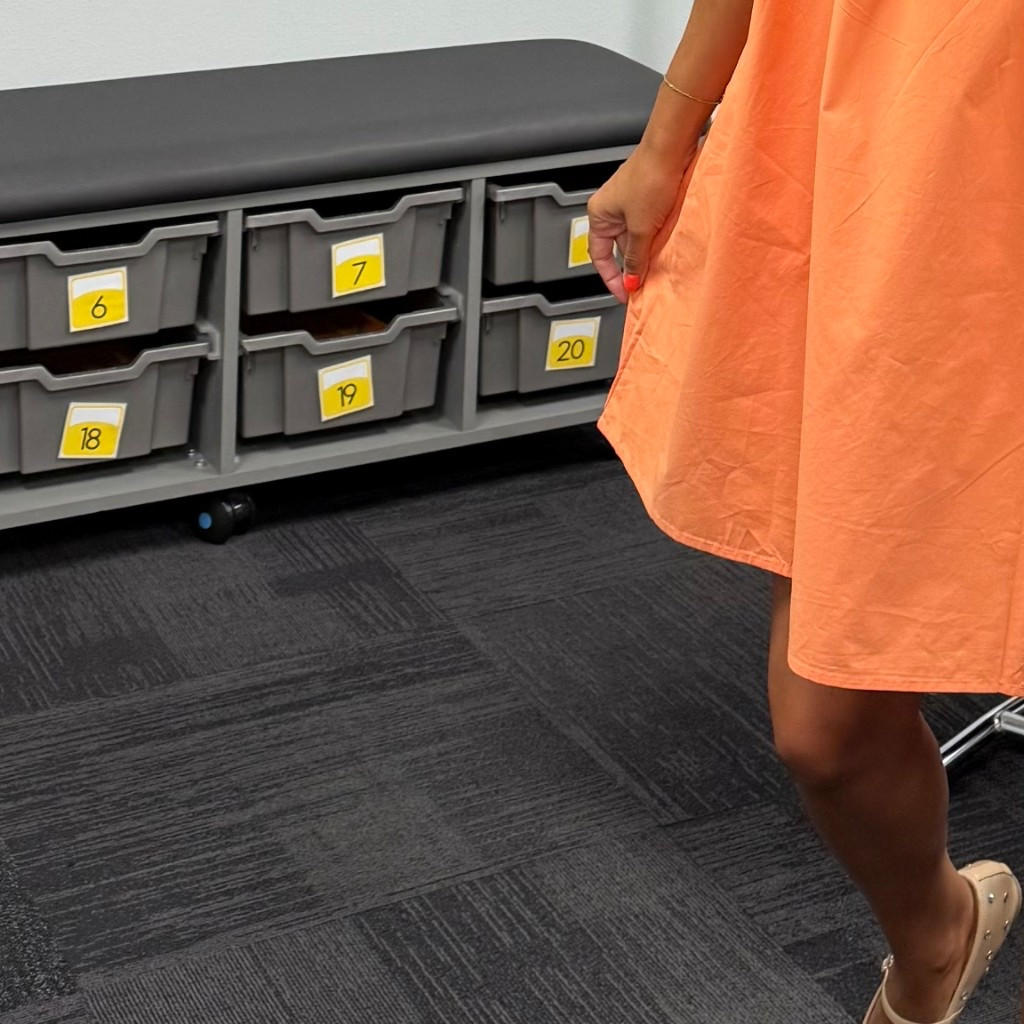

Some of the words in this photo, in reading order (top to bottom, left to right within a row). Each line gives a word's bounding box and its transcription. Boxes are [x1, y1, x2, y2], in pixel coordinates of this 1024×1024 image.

[351, 260, 368, 286] 7
[91, 296, 108, 320] 6
[555, 338, 586, 364] 20
[336, 382, 358, 410] 19
[79, 425, 102, 452] 18
